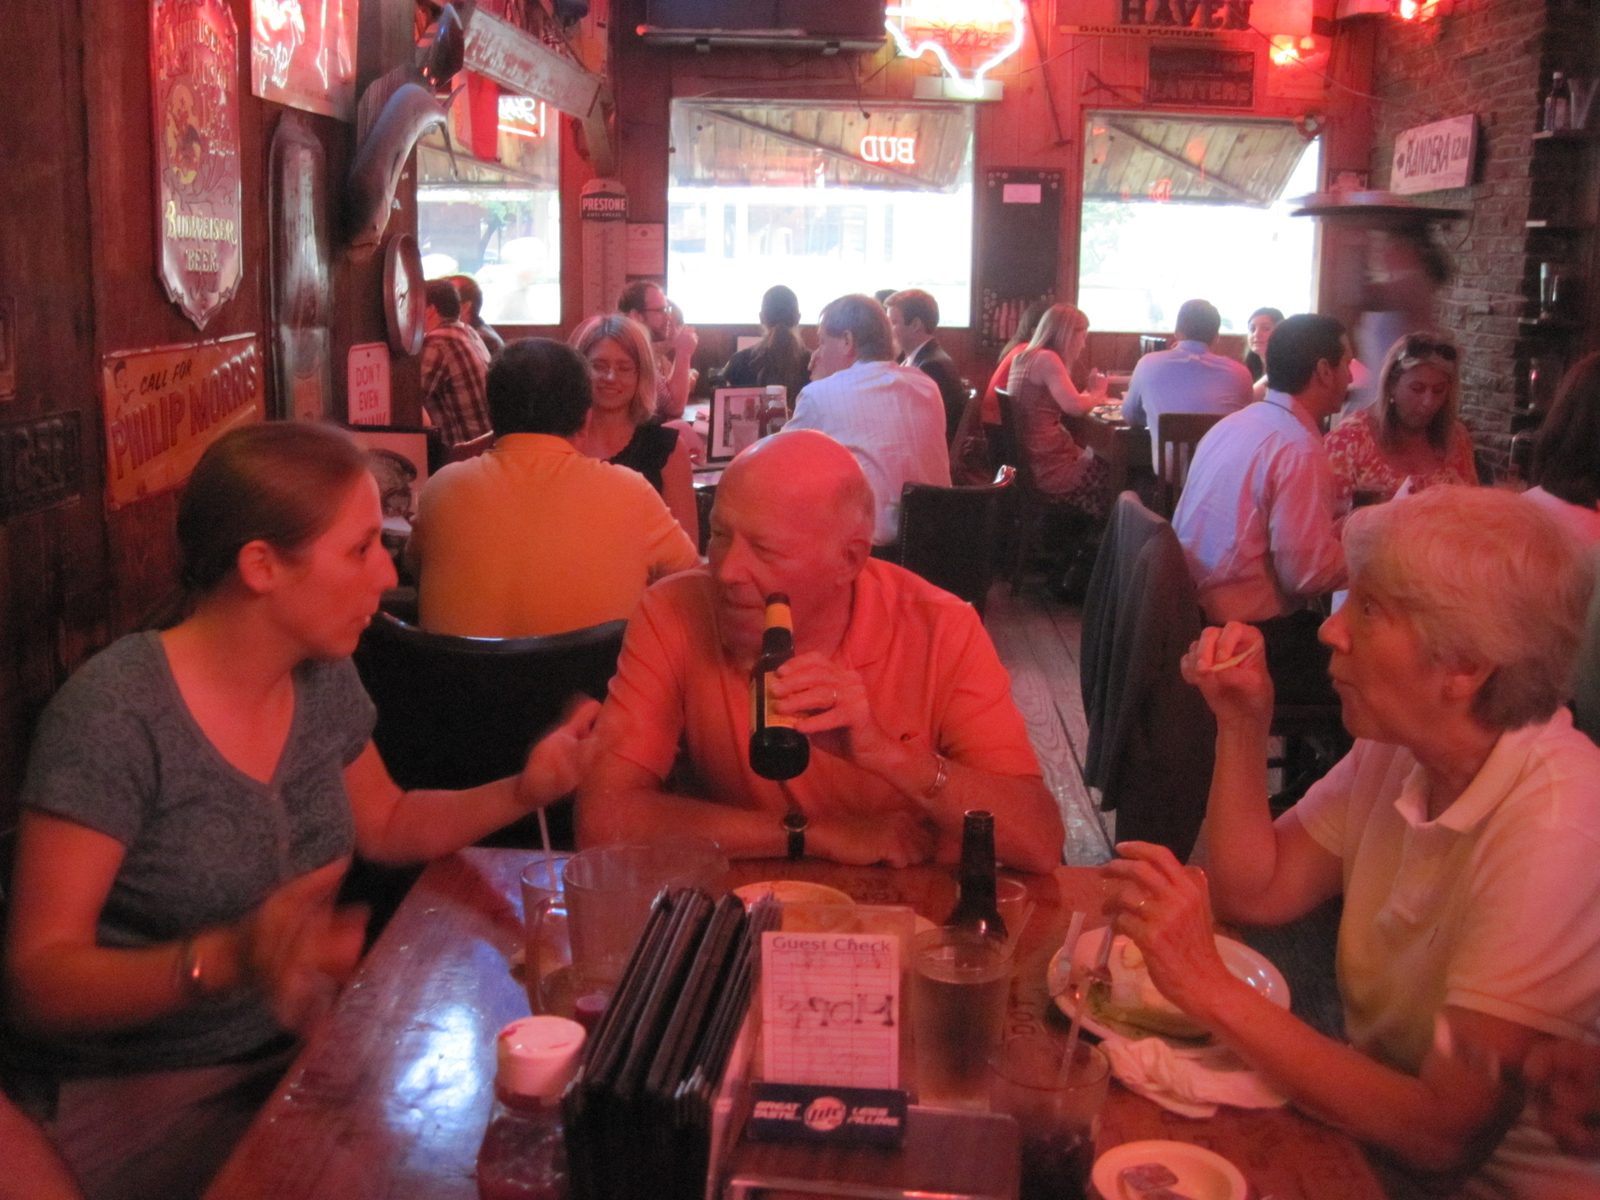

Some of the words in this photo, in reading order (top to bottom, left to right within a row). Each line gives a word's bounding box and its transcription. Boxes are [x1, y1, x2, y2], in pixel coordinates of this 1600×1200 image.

[1120, 0, 1251, 31] HAVEN
[1404, 133, 1450, 178] BANDERA
[582, 198, 626, 211] PRESTONE
[165, 200, 238, 245] BUDWEISER
[186, 249, 219, 273] BEER
[140, 369, 168, 395] CALL
[172, 358, 193, 384] FOR
[111, 391, 186, 480] PHILIP
[189, 343, 256, 437] MORRIS
[359, 389, 380, 412] EVEN
[772, 935, 827, 951] Guest
[833, 936, 891, 953] Check
